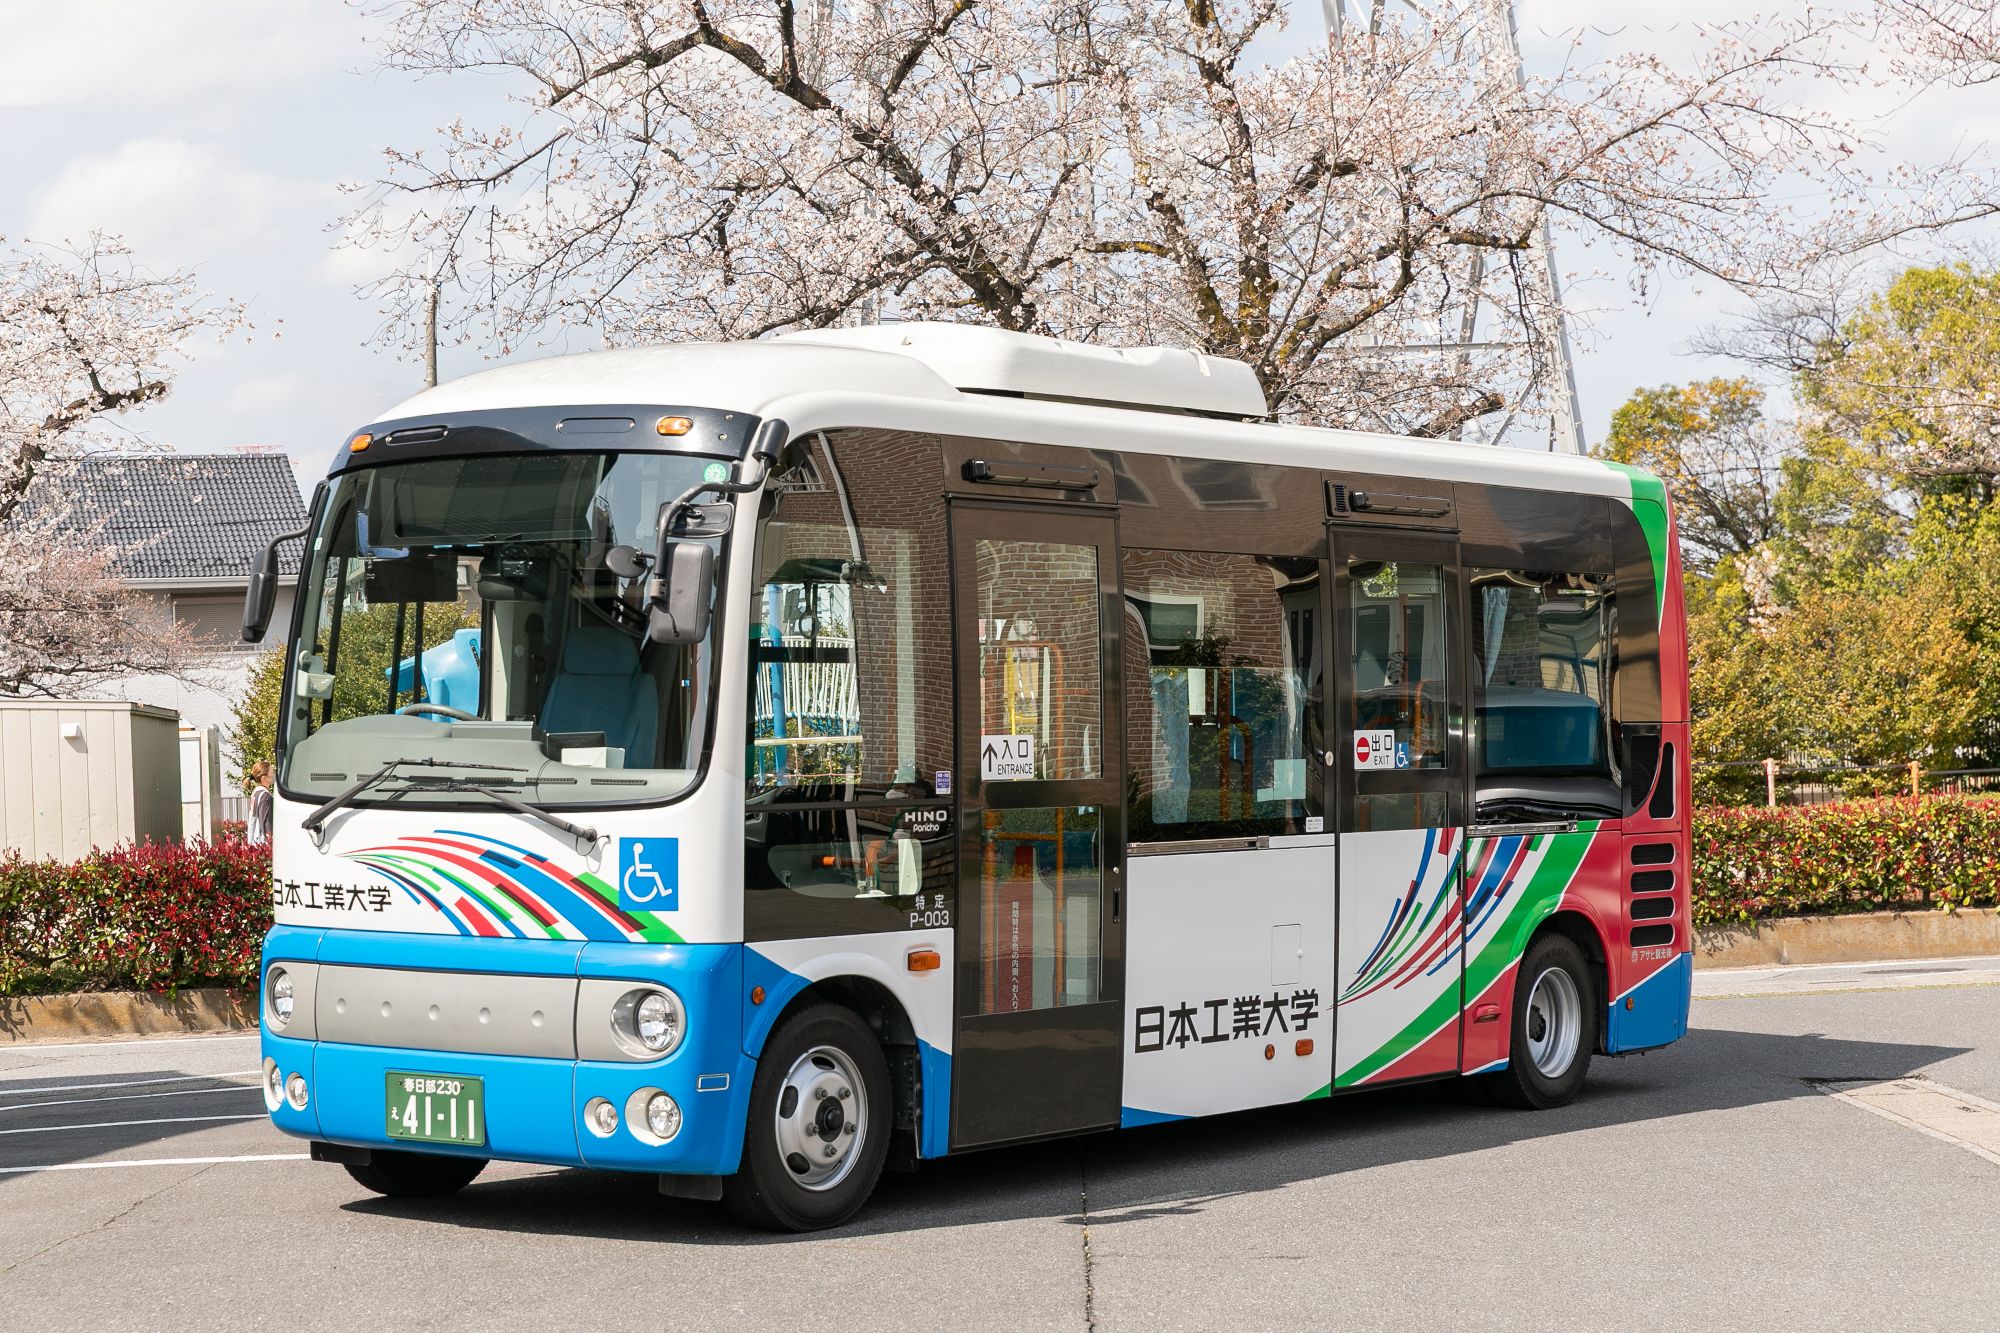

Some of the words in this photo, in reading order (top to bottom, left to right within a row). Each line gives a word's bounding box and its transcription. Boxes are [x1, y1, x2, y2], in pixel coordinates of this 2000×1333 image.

[1002, 740, 1028, 760] 入口
[1371, 734, 1392, 751] 出口
[1374, 755, 1389, 765] EXIT
[998, 763, 1032, 775] ENTRANCE
[905, 810, 947, 822] HINO
[273, 878, 392, 912] 日本工業大学
[915, 894, 944, 910] 特定
[910, 910, 950, 928] P-003
[1135, 989, 1319, 1054] 日本工業大学
[403, 1095, 475, 1140] 41-11
